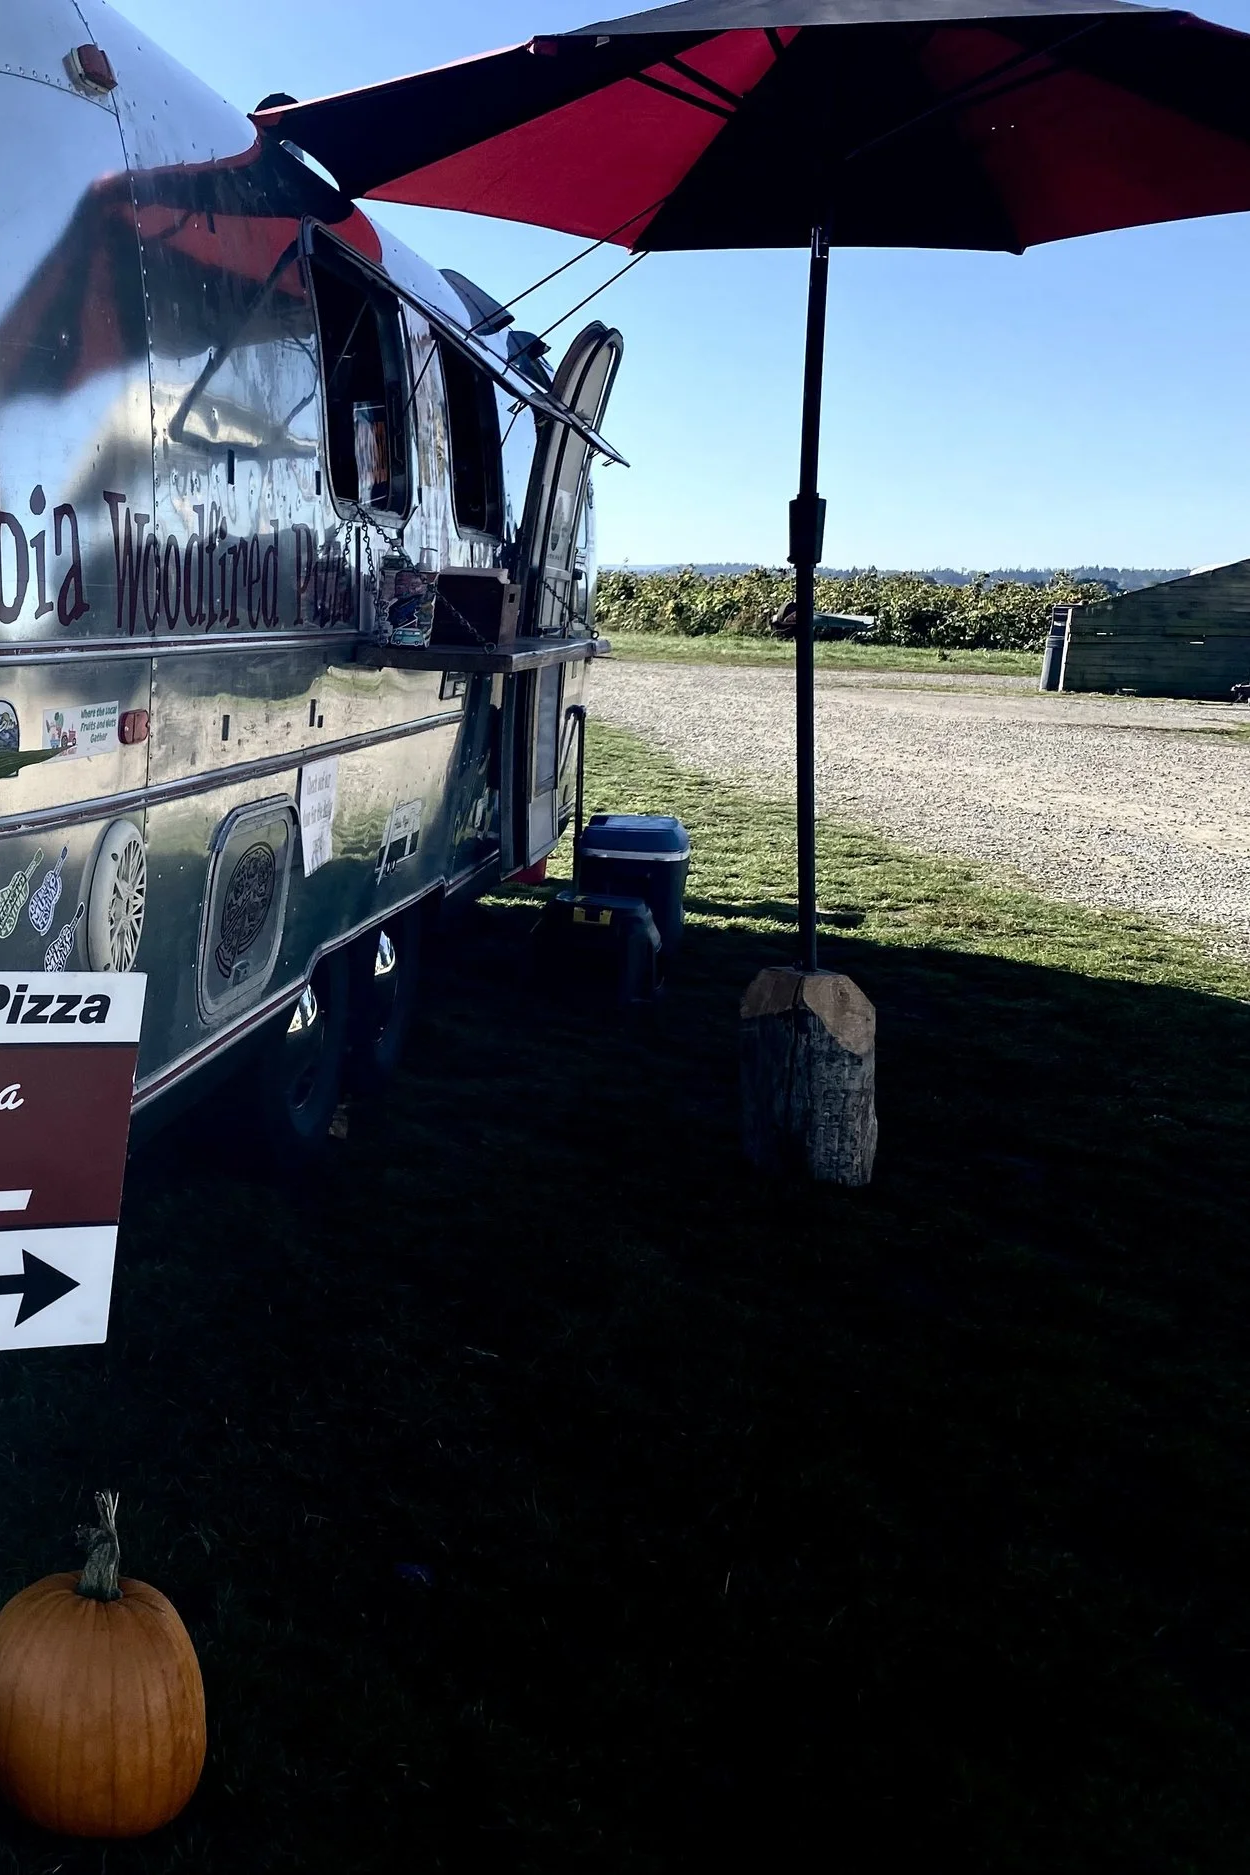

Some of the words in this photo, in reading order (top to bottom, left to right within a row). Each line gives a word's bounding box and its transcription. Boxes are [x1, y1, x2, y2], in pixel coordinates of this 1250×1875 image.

[102, 490, 280, 637] Woodfired
[80, 708, 96, 720] Where
[96, 706, 105, 718] the
[80, 720, 96, 732] Fruits
[96, 719, 106, 730] and
[90, 732, 108, 744] Gather
